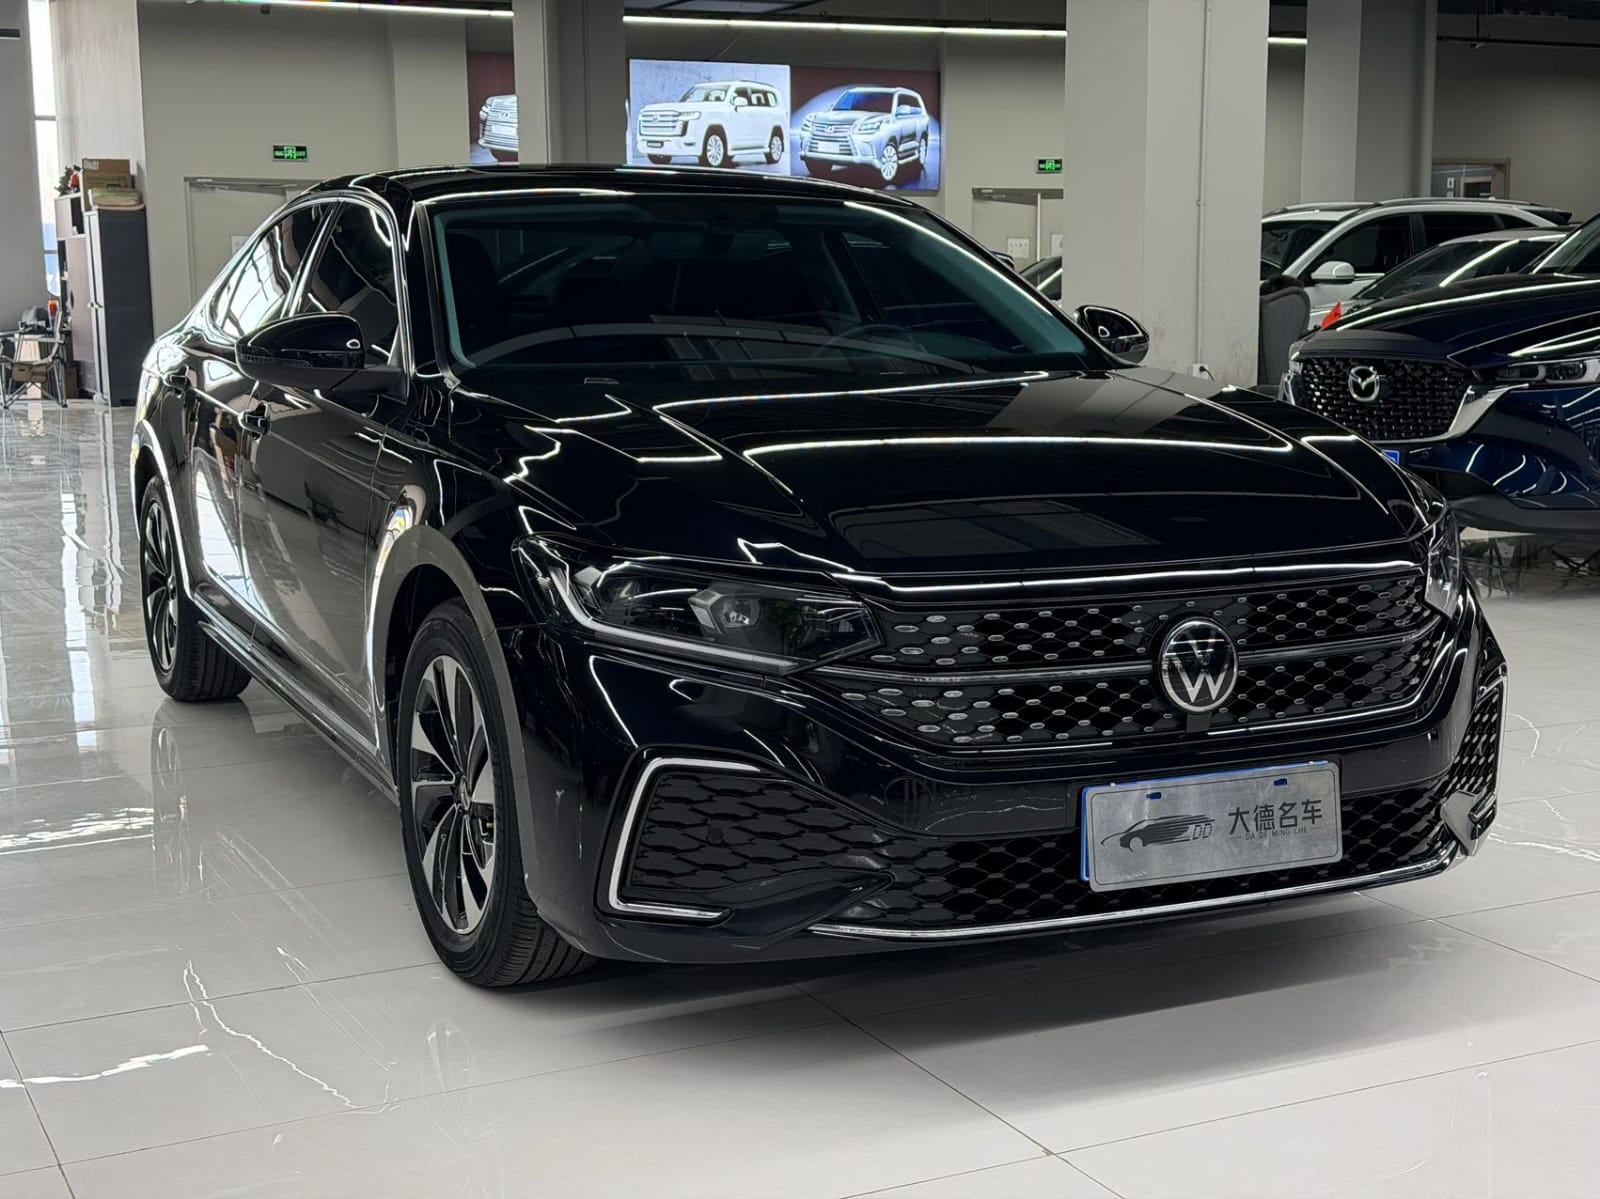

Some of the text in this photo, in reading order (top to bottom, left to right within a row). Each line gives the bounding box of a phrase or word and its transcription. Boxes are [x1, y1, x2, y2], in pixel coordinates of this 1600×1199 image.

[1228, 799, 1322, 834] 大德名车
[1245, 832, 1256, 840] DA
[1272, 828, 1291, 836] MING
